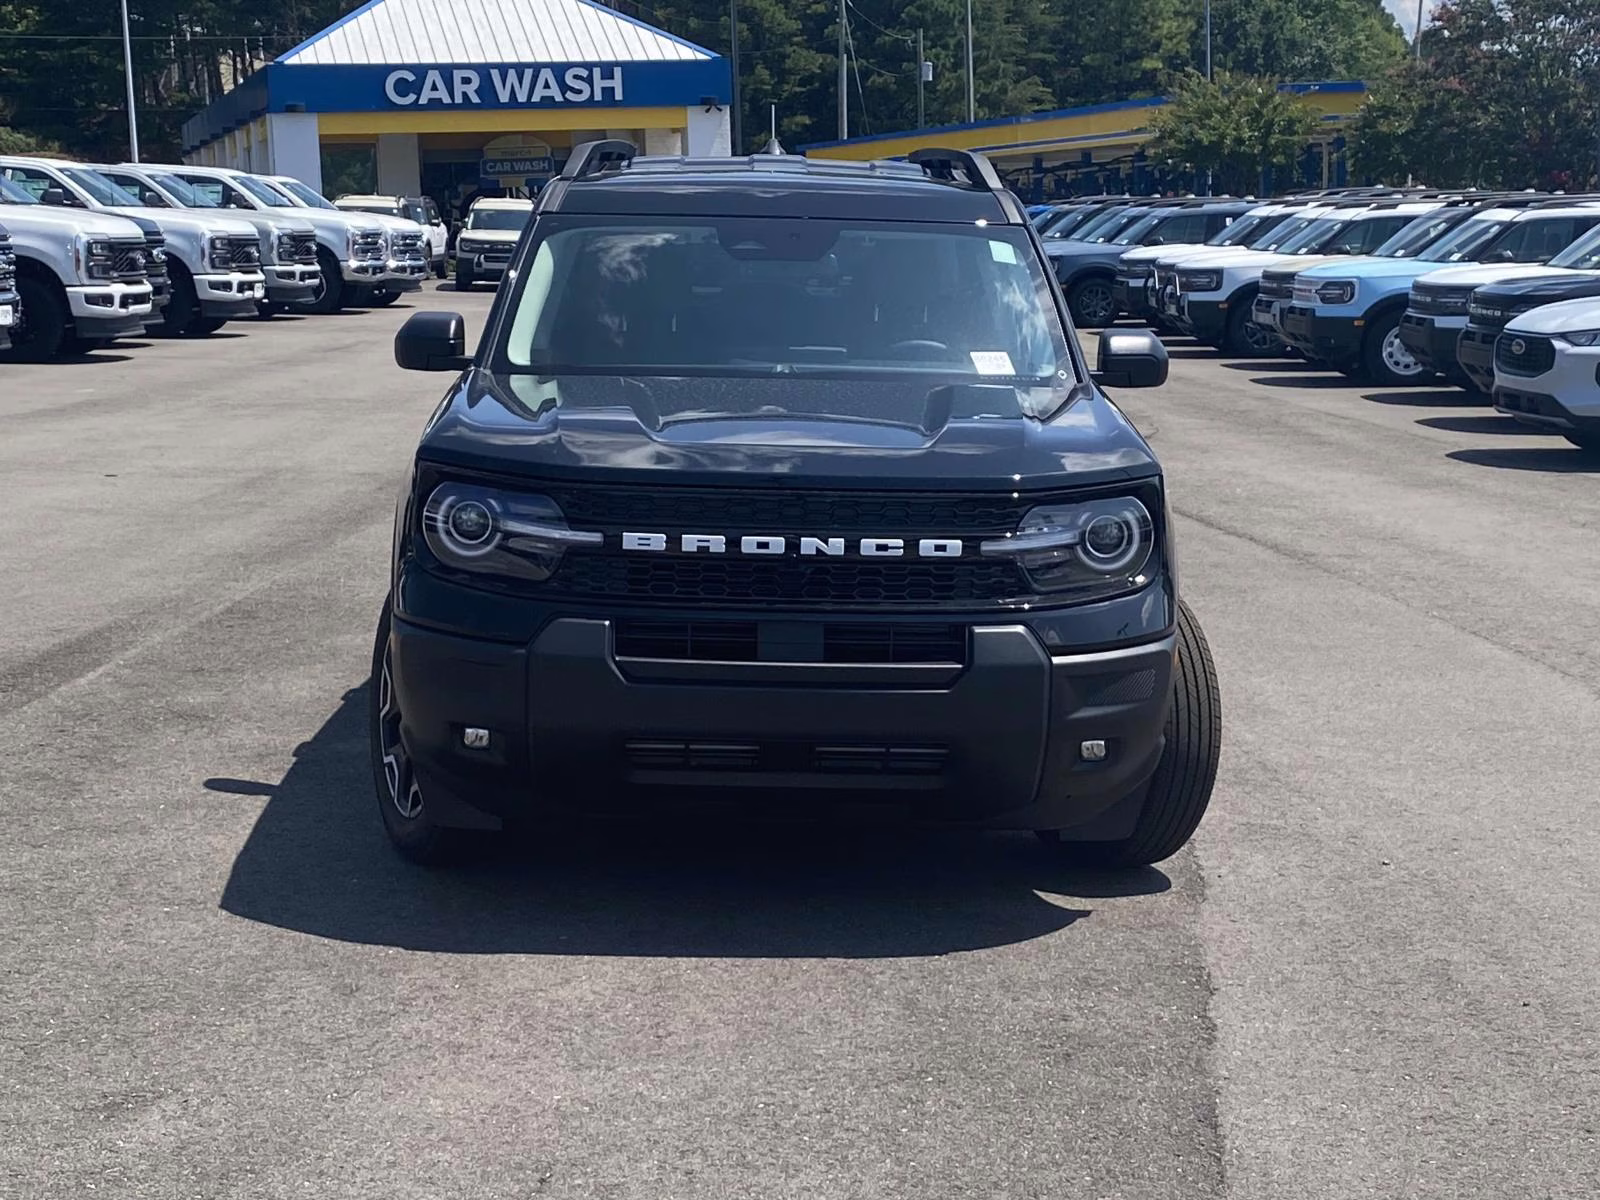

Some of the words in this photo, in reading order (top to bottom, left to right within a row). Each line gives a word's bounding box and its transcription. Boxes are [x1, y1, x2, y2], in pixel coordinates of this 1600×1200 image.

[384, 69, 481, 105] CAR
[489, 66, 624, 103] WASH
[486, 162, 512, 172] CAR
[512, 160, 549, 171] WASH
[622, 532, 963, 557] BRONCO
